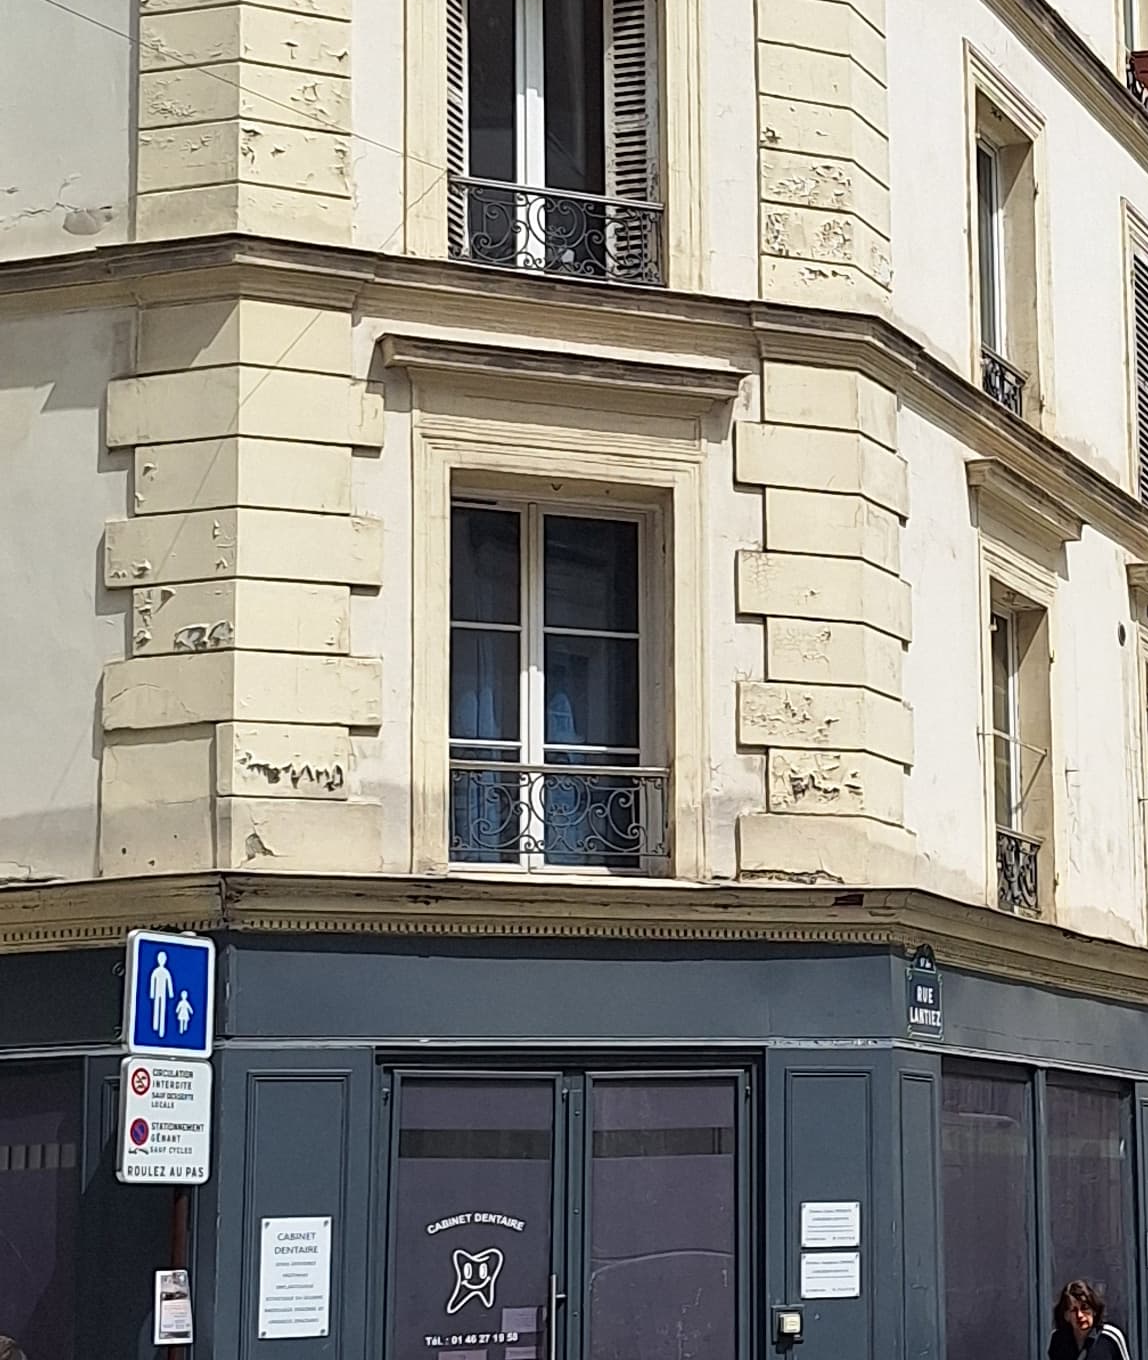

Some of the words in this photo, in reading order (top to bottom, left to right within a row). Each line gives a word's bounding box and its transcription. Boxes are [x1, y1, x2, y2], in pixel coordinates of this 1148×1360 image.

[916, 985, 934, 1004] RUE
[909, 1006, 941, 1027] LANTIEZ
[152, 1080, 192, 1090] INTERDITE
[151, 1122, 205, 1132] STATIONNEMENT
[127, 1165, 166, 1177] ROULEZ
[169, 1166, 183, 1177] AU
[185, 1167, 204, 1178] PAS
[426, 1213, 473, 1235] CABINET
[474, 1212, 525, 1232] DENTAIRE
[276, 1232, 317, 1241] CABINET
[274, 1245, 319, 1255] DENTAIRE
[451, 1335, 463, 1345] 01
